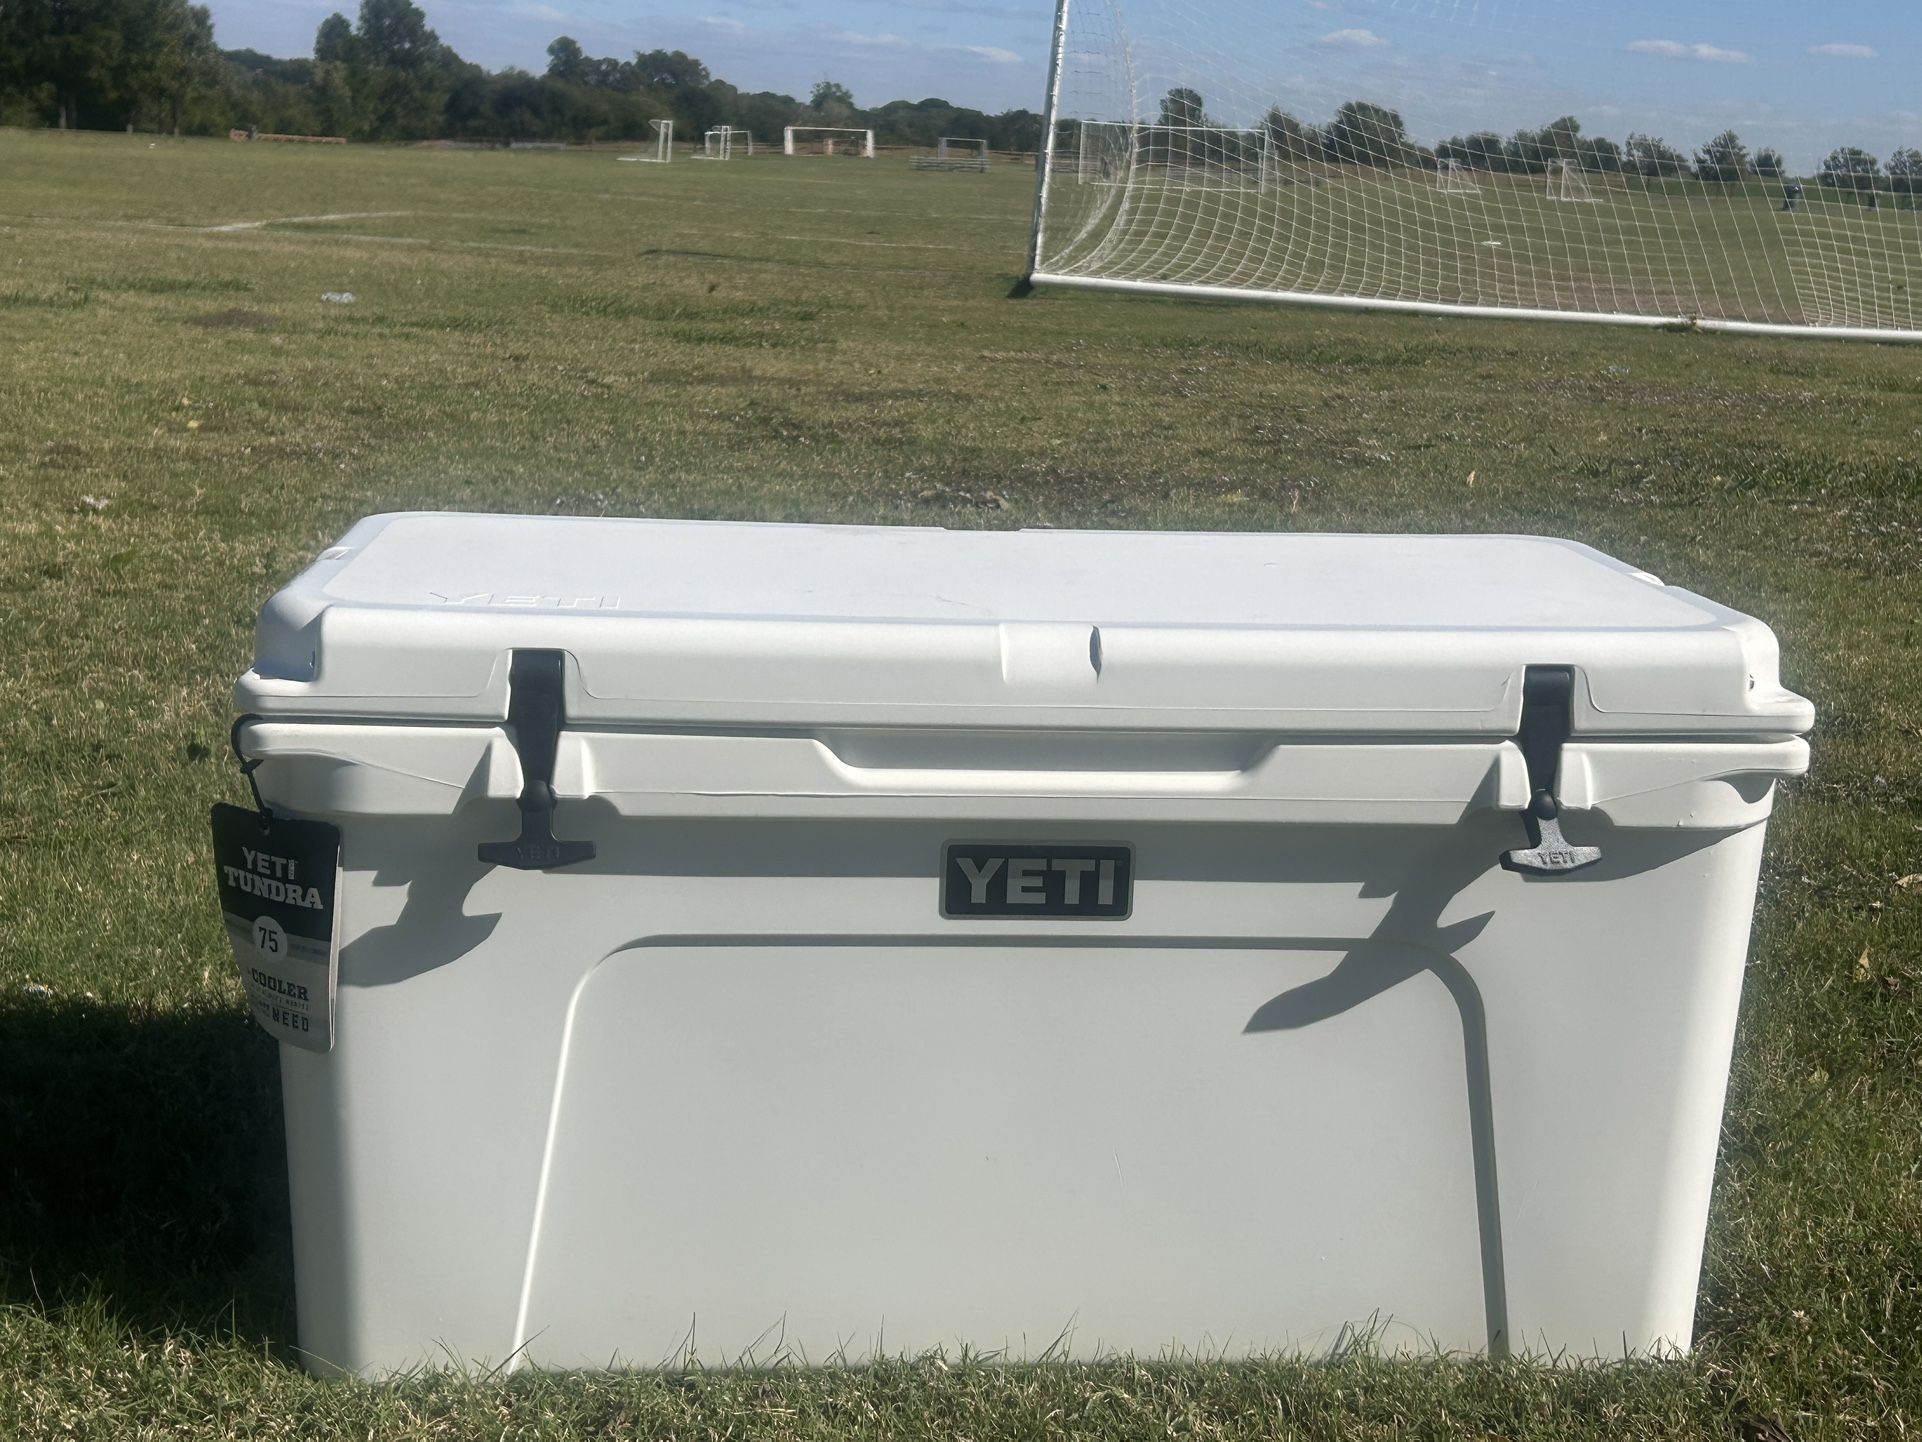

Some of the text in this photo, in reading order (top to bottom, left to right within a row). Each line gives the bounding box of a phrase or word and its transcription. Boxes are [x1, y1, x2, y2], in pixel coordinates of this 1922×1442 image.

[429, 591, 620, 609] YETI
[242, 846, 295, 880] YETI
[1538, 851, 1576, 865] YETI
[223, 865, 324, 910] TUNDRA
[955, 857, 1116, 905] YETI
[258, 926, 279, 953] 75
[251, 967, 309, 1002] COOLER
[272, 1007, 309, 1032] NEED
